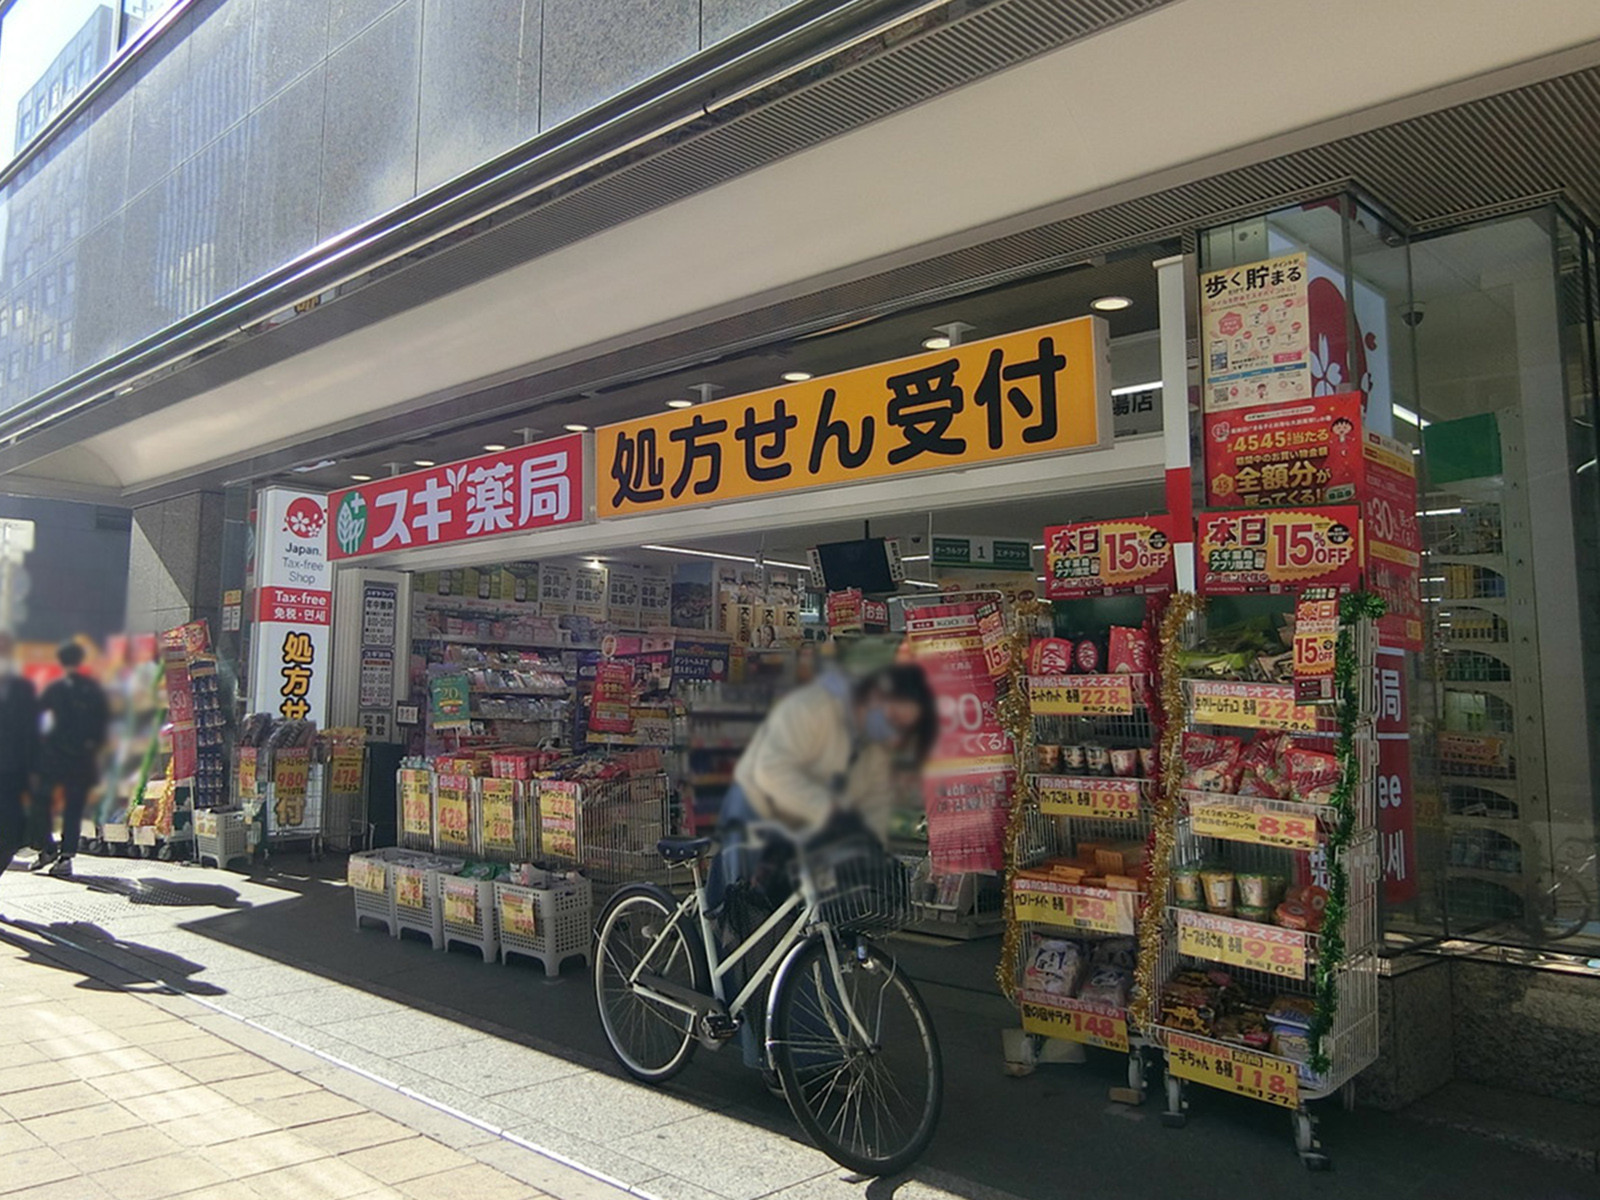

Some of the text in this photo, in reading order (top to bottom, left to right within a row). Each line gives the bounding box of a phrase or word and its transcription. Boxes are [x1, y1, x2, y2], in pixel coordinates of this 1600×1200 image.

[1205, 266, 1302, 298] 歩く 貯まる
[611, 336, 1067, 508] 処方せん受付
[1234, 430, 1286, 452] 4545
[1235, 461, 1331, 493] 全額分が
[373, 451, 570, 549] スギ薬局
[1052, 529, 1099, 556] 本日
[1140, 553, 1167, 567] OFF
[1208, 518, 1267, 546] 本日
[1314, 548, 1348, 564] OFF
[977, 546, 986, 559] 1
[282, 557, 324, 571] Tax-free
[288, 571, 316, 585] Shop
[275, 590, 327, 606] Tax-free
[1297, 602, 1335, 619] 本日
[1195, 683, 1294, 699] 南船場オスス
